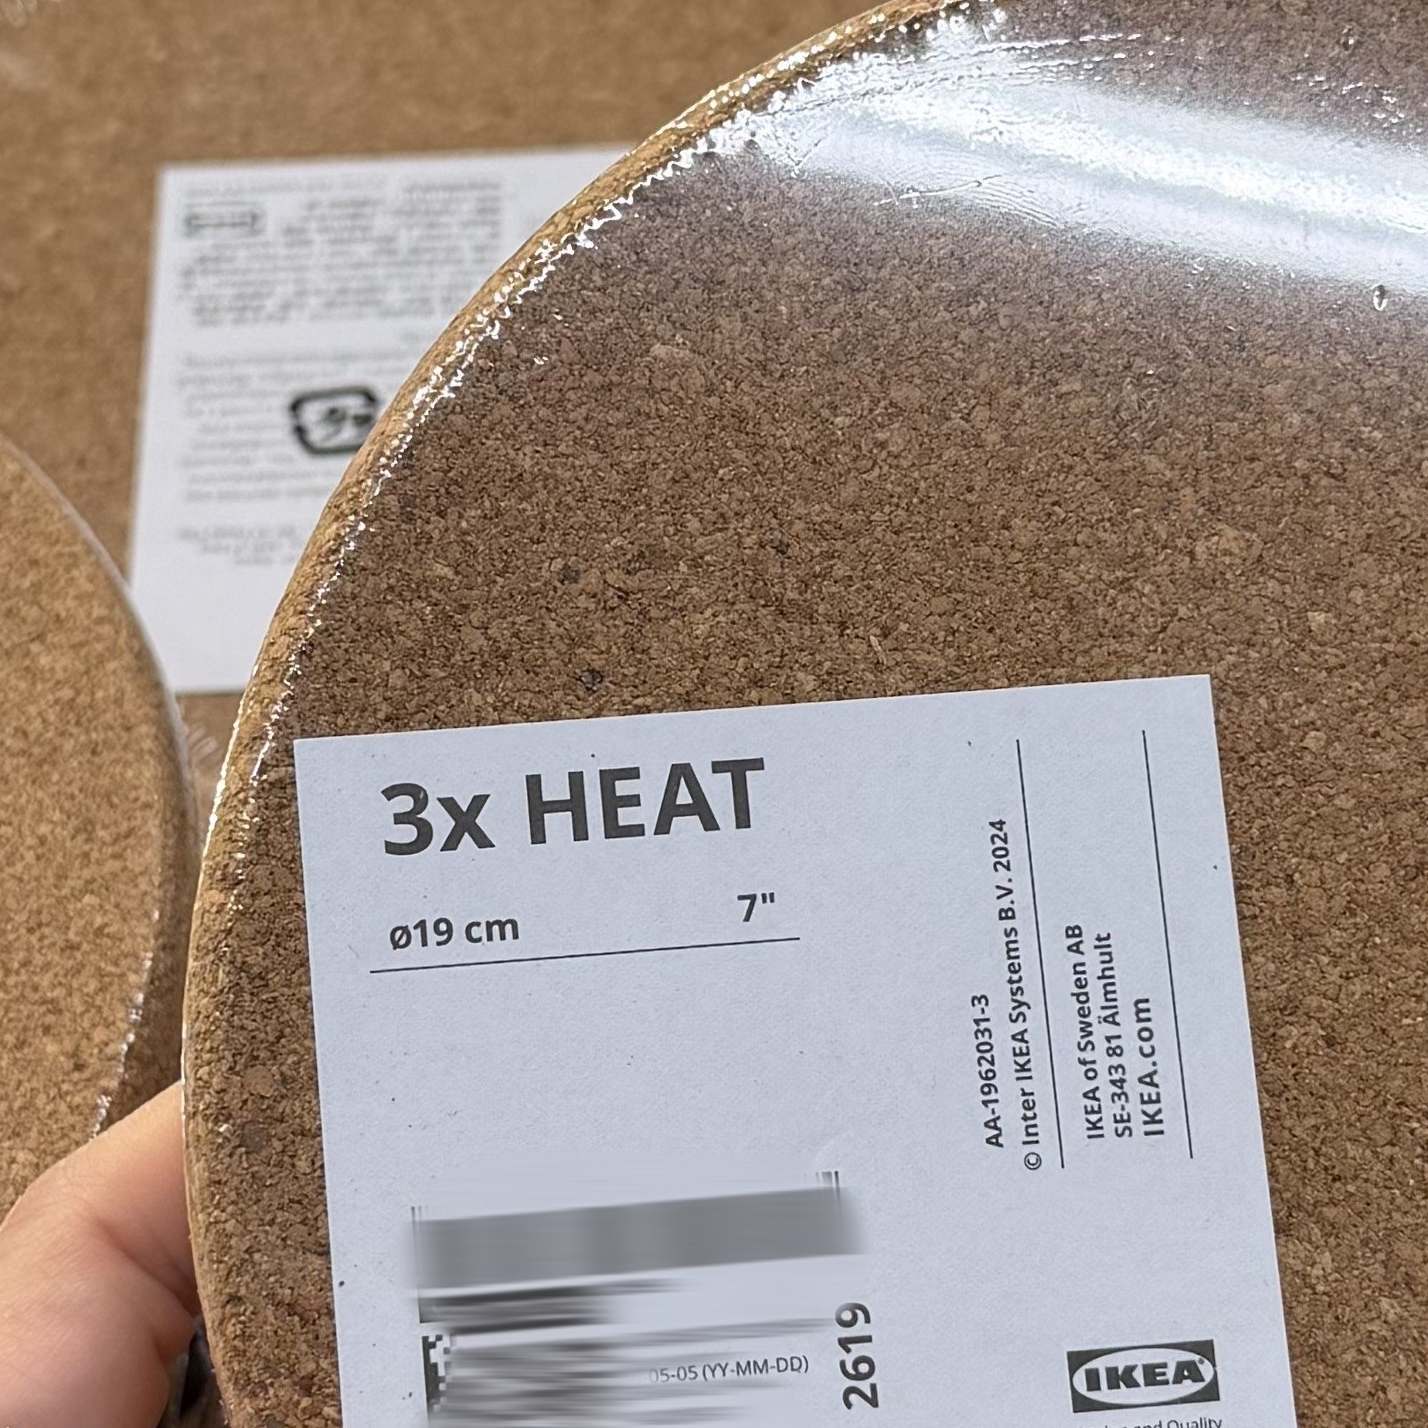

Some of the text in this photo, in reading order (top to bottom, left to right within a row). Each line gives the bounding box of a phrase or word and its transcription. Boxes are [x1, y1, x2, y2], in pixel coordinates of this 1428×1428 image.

[380, 757, 765, 856] 3x HEAT
[988, 818, 1011, 873] 2024
[464, 917, 520, 943] cm
[736, 892, 776, 923] 7"
[996, 878, 1017, 922] B.V.
[1004, 926, 1031, 1024] Systems
[1011, 1028, 1034, 1082] IKEA
[1065, 924, 1105, 1140] IKEA of Sweden AB
[1093, 932, 1133, 1139] SE-343 81 Älmhult
[1133, 997, 1165, 1138] IKEA.com
[971, 994, 1004, 1149] AA-1962031-3
[1020, 1087, 1040, 1146] Inter
[702, 1355, 810, 1382] (YY-MM-DD)
[834, 1301, 880, 1410] 2619
